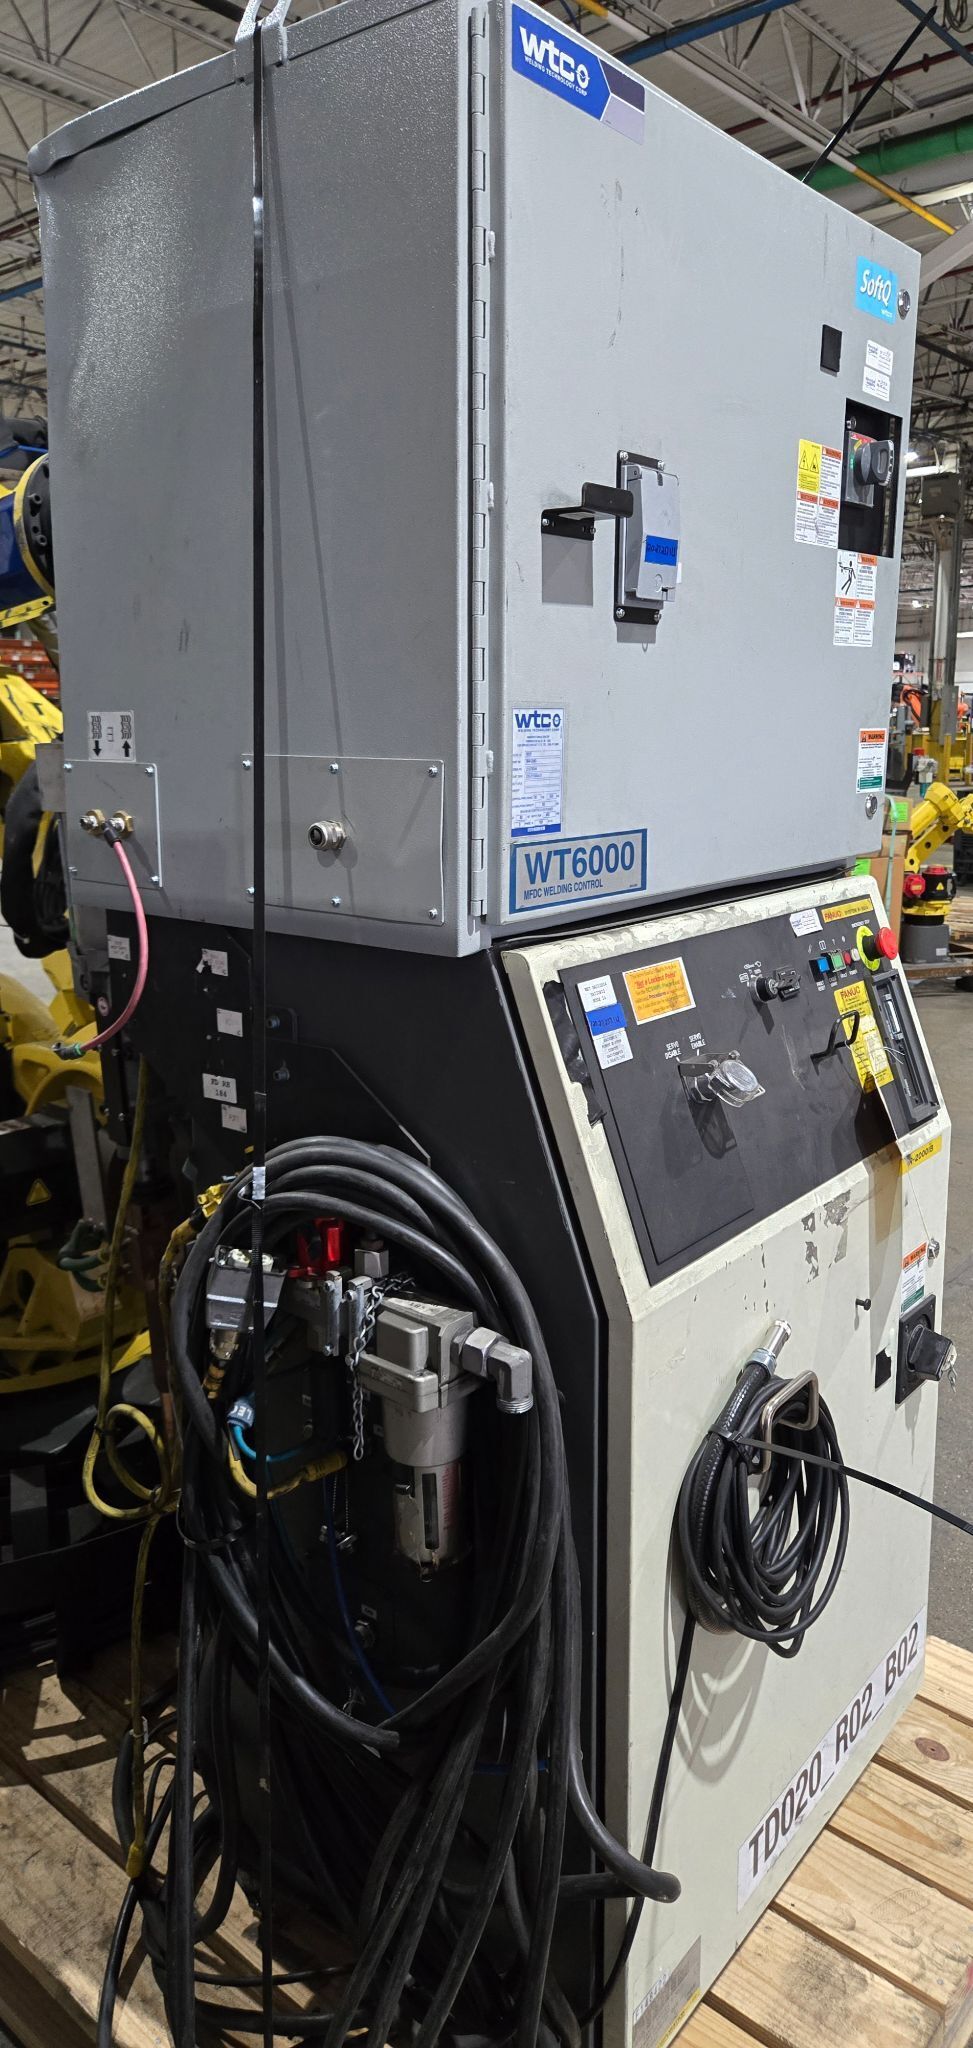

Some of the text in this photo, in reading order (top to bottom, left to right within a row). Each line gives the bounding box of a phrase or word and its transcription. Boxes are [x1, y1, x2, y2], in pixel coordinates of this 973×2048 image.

[524, 55, 588, 97] WELDING TECHNOLOGY CORP
[860, 269, 892, 307] SoftQ
[515, 710, 562, 729] wtco
[524, 841, 635, 885] WT6000
[523, 878, 604, 901] MFDC WELDING CONTROL
[824, 910, 842, 920] FANUC
[840, 985, 861, 1000] FANUC
[748, 1621, 919, 1879] TD020_R02_B02
